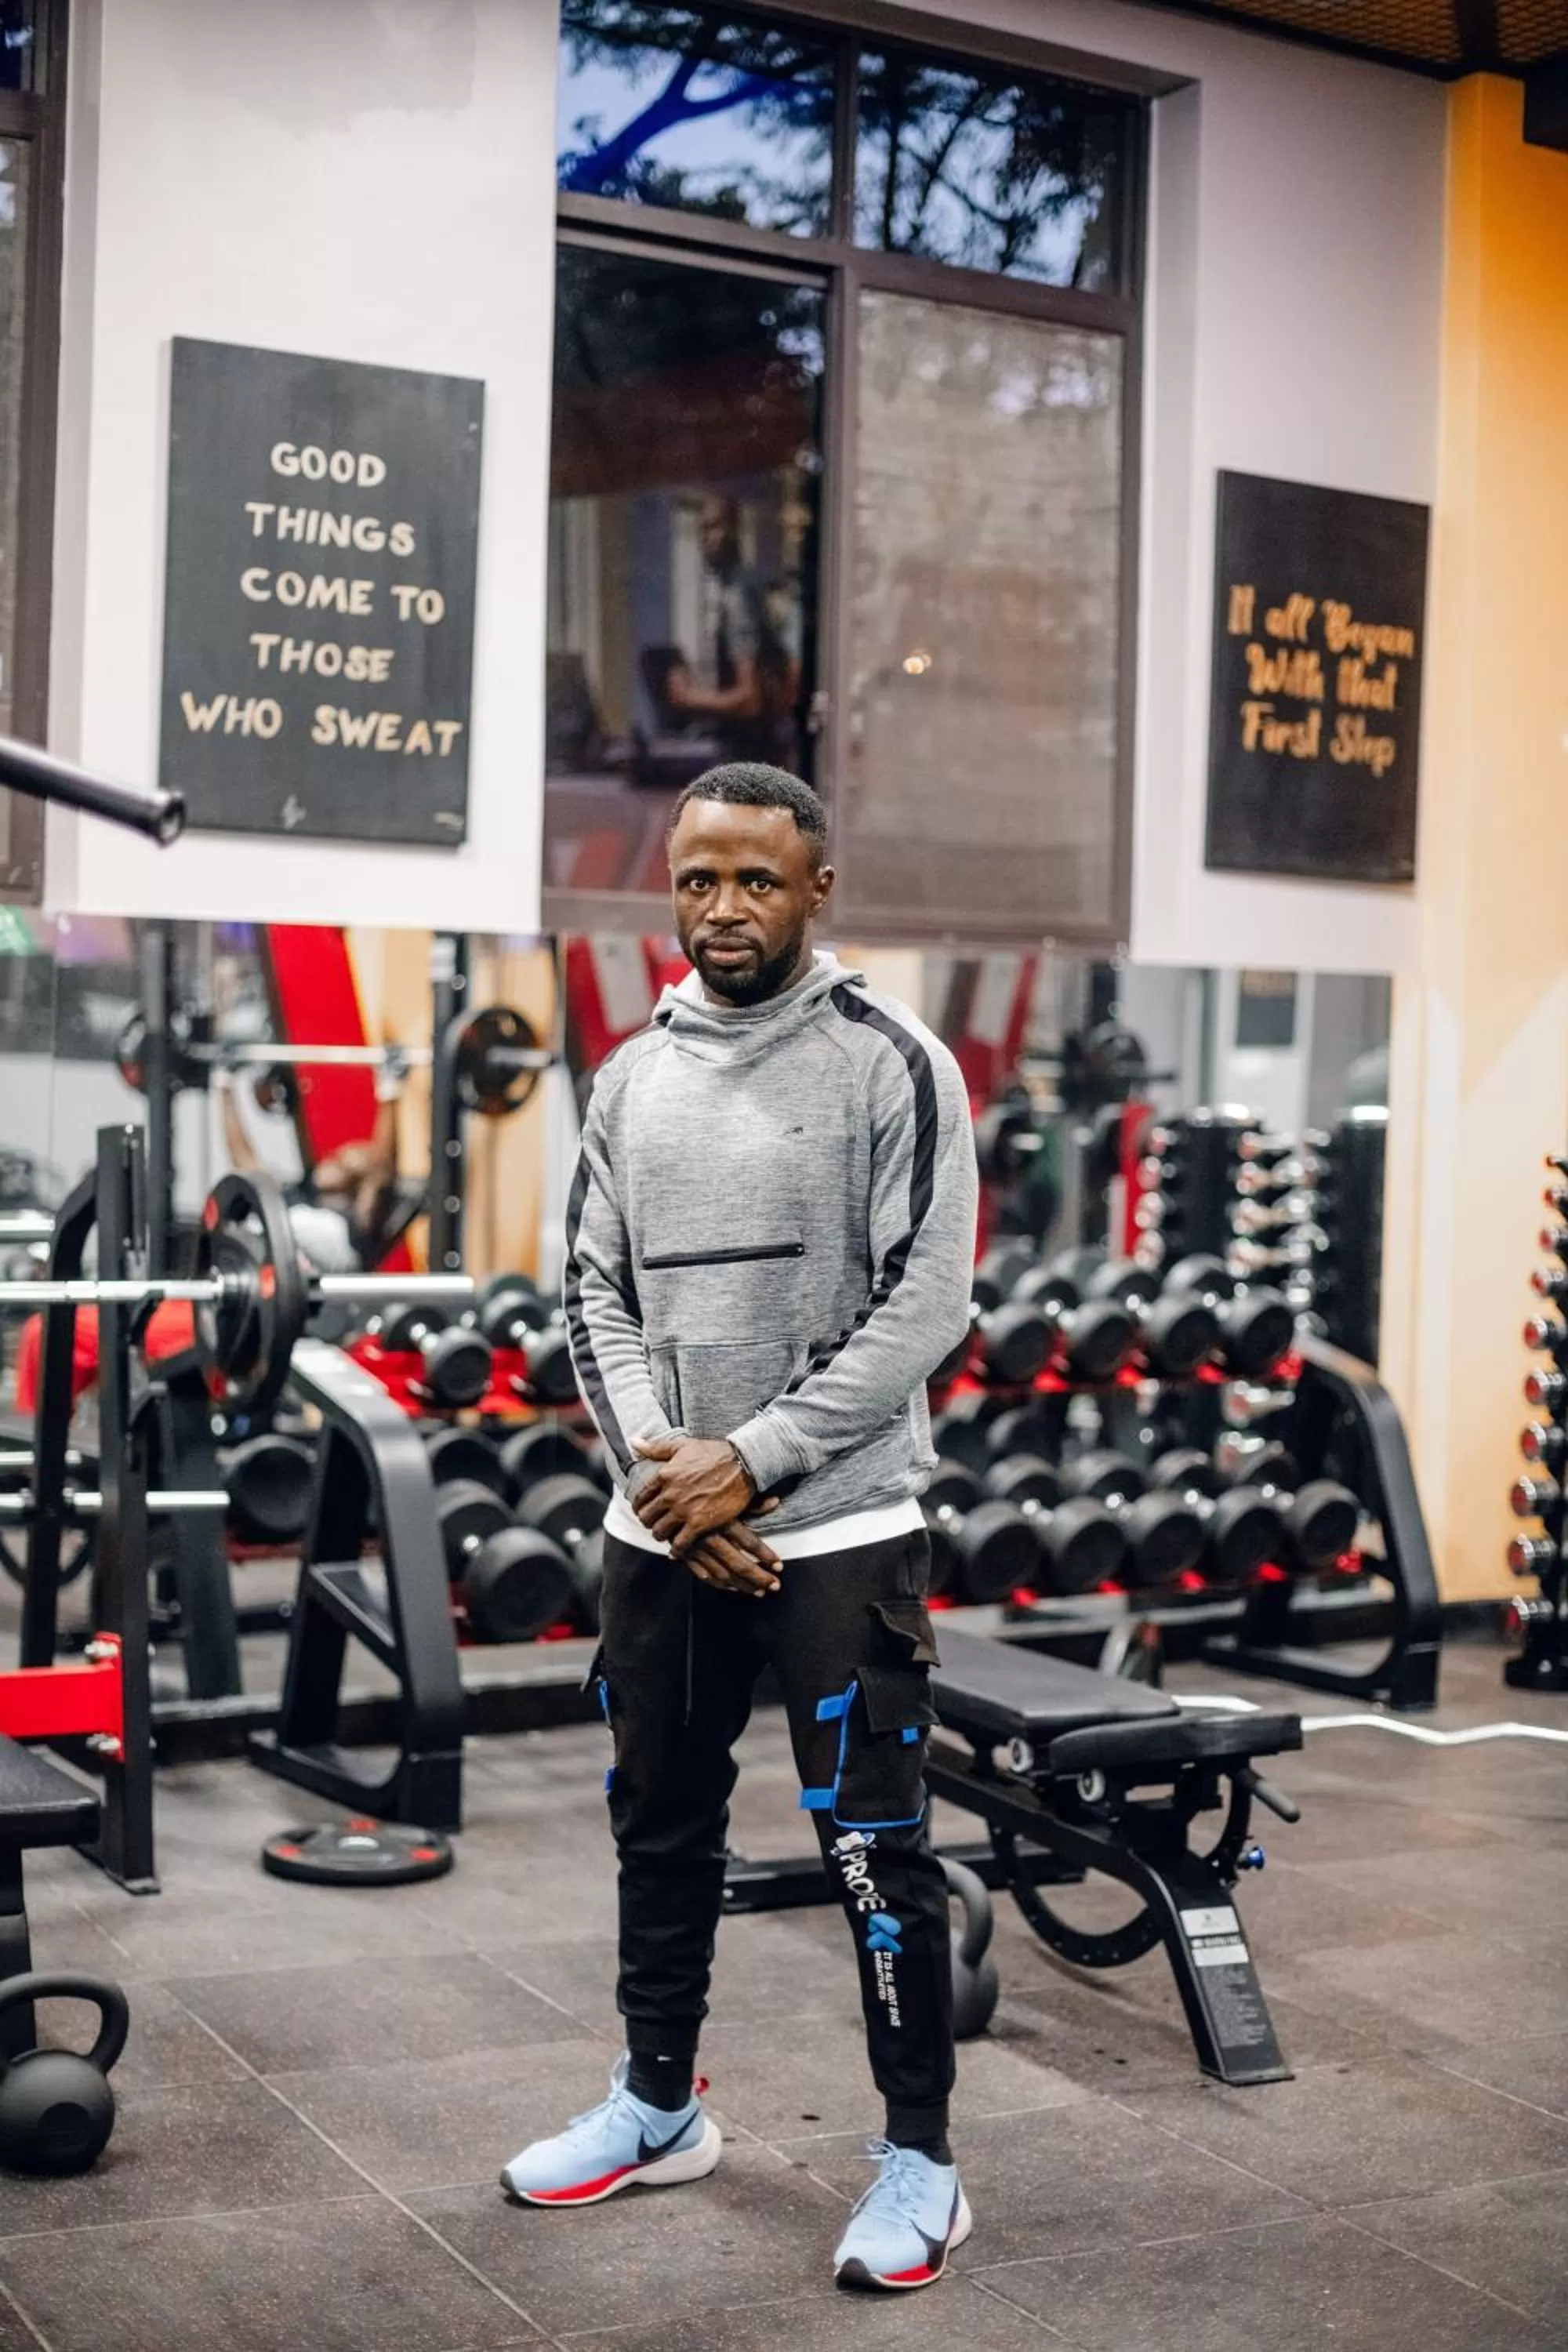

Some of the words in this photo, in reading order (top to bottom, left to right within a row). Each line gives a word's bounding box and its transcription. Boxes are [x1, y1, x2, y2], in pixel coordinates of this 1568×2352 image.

[270, 441, 387, 488] GOOD
[244, 500, 416, 557] THINGS
[239, 566, 376, 616] COME
[390, 584, 445, 625] TO
[249, 632, 395, 683] THOSE
[180, 691, 283, 739] WHO
[310, 704, 463, 757] SWEAT
